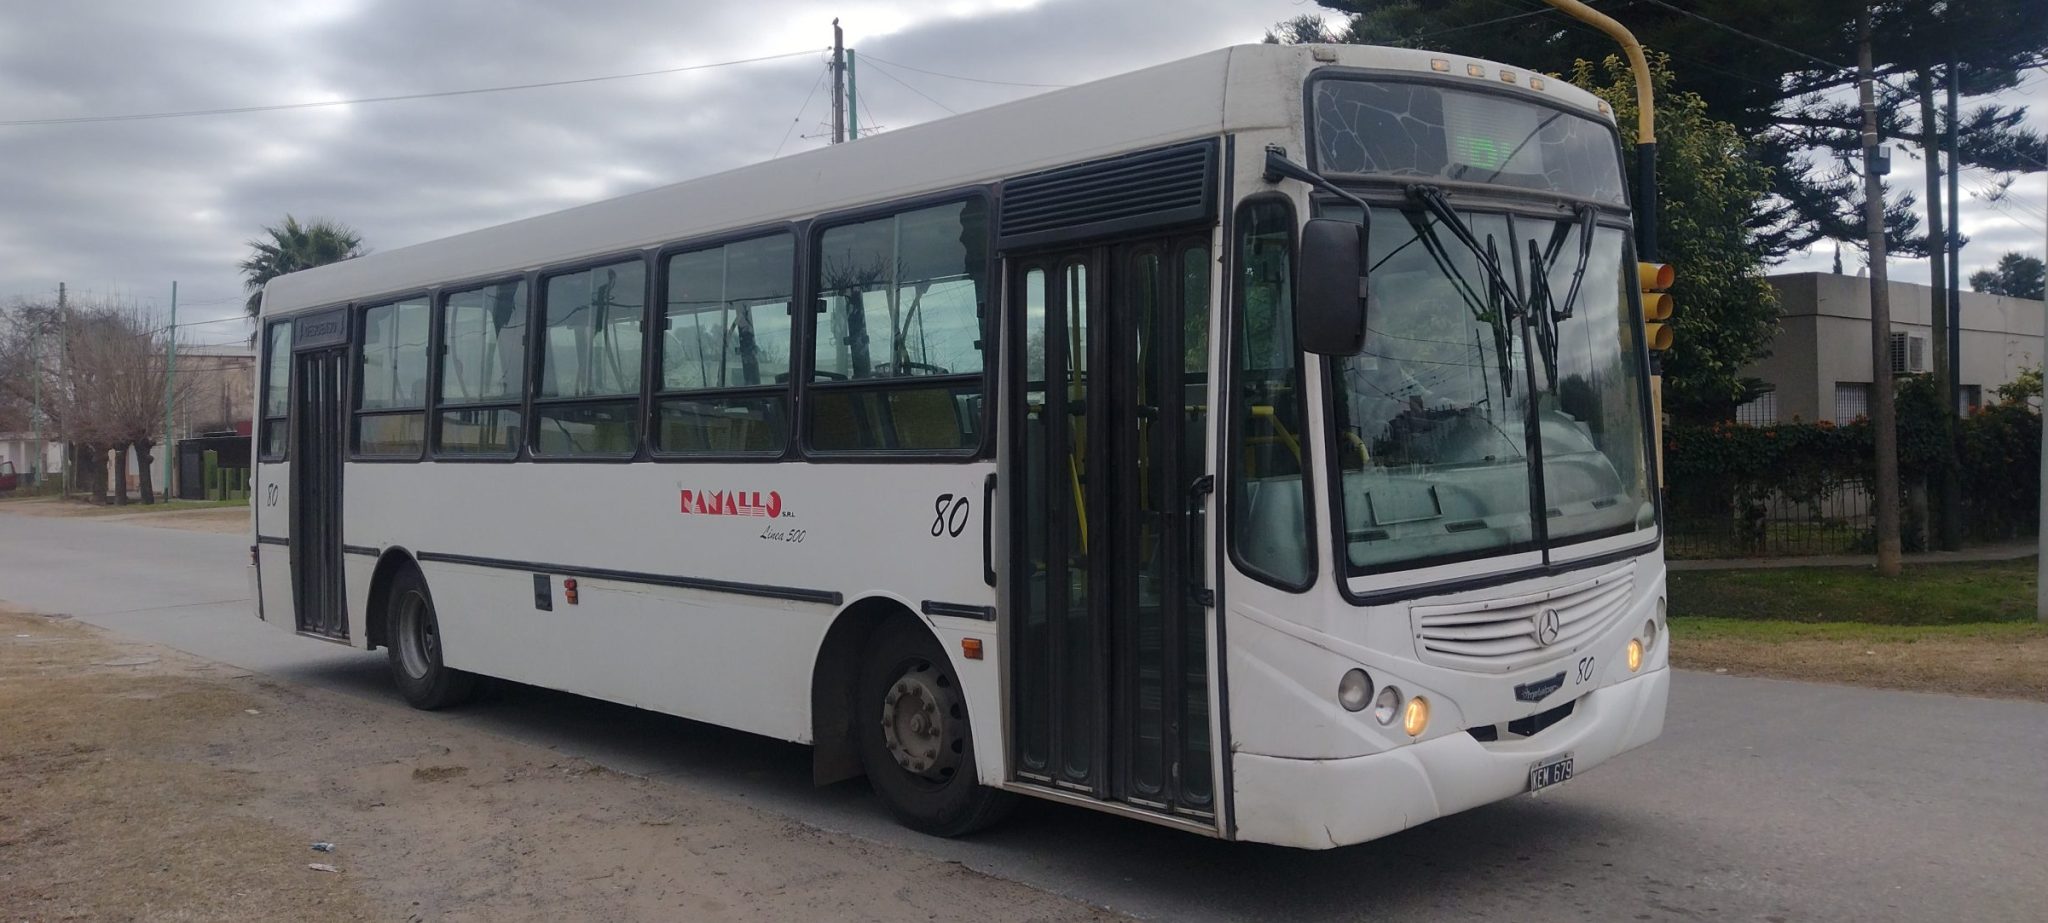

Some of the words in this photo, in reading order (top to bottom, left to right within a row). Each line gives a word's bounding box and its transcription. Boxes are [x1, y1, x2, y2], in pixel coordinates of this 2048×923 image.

[267, 483, 279, 507] 80
[680, 489, 782, 518] RAMALLO
[931, 493, 970, 538] 80
[786, 529, 806, 543] 500
[1575, 656, 1595, 685] 80
[1553, 760, 1572, 782] 679
